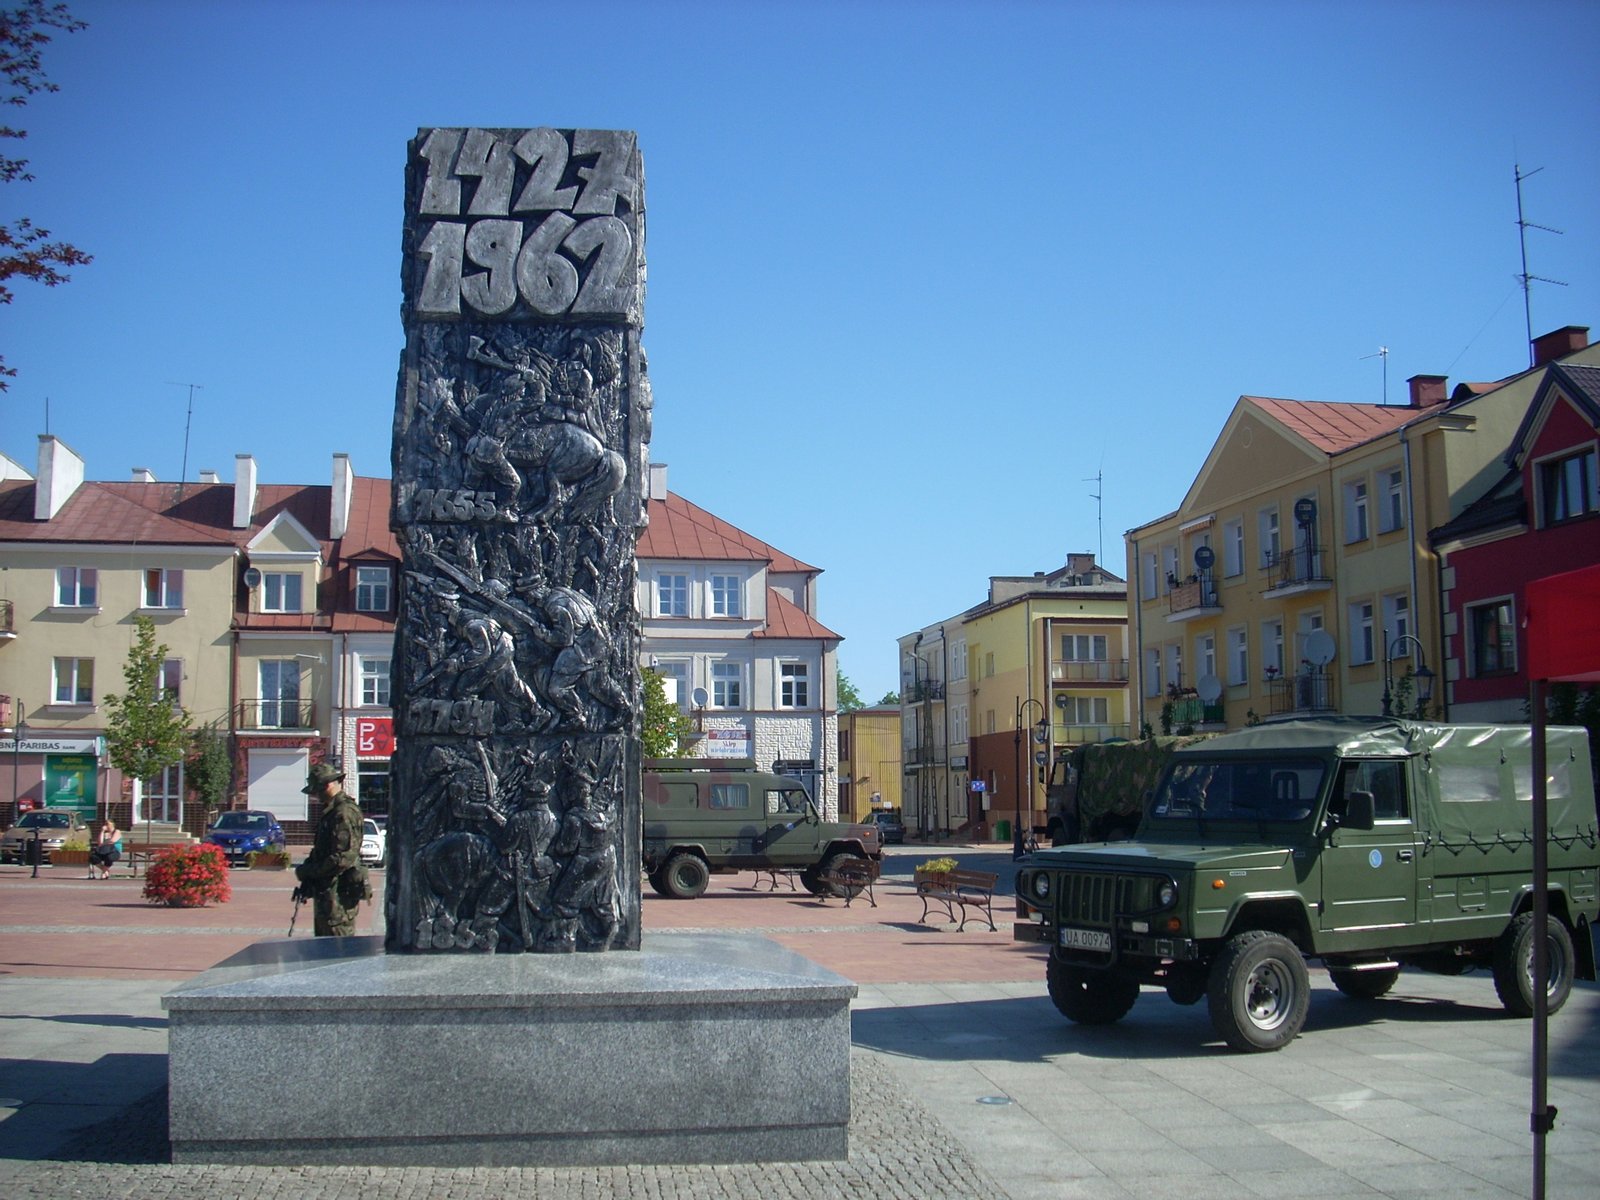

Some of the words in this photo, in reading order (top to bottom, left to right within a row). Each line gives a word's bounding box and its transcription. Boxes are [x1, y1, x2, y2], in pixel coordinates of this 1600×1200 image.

[419, 128, 638, 216] 1427
[415, 488, 497, 521] 1655
[20, 741, 60, 750] PARIBAS
[1066, 930, 1079, 945] UA
[1081, 932, 1110, 949] 00974
